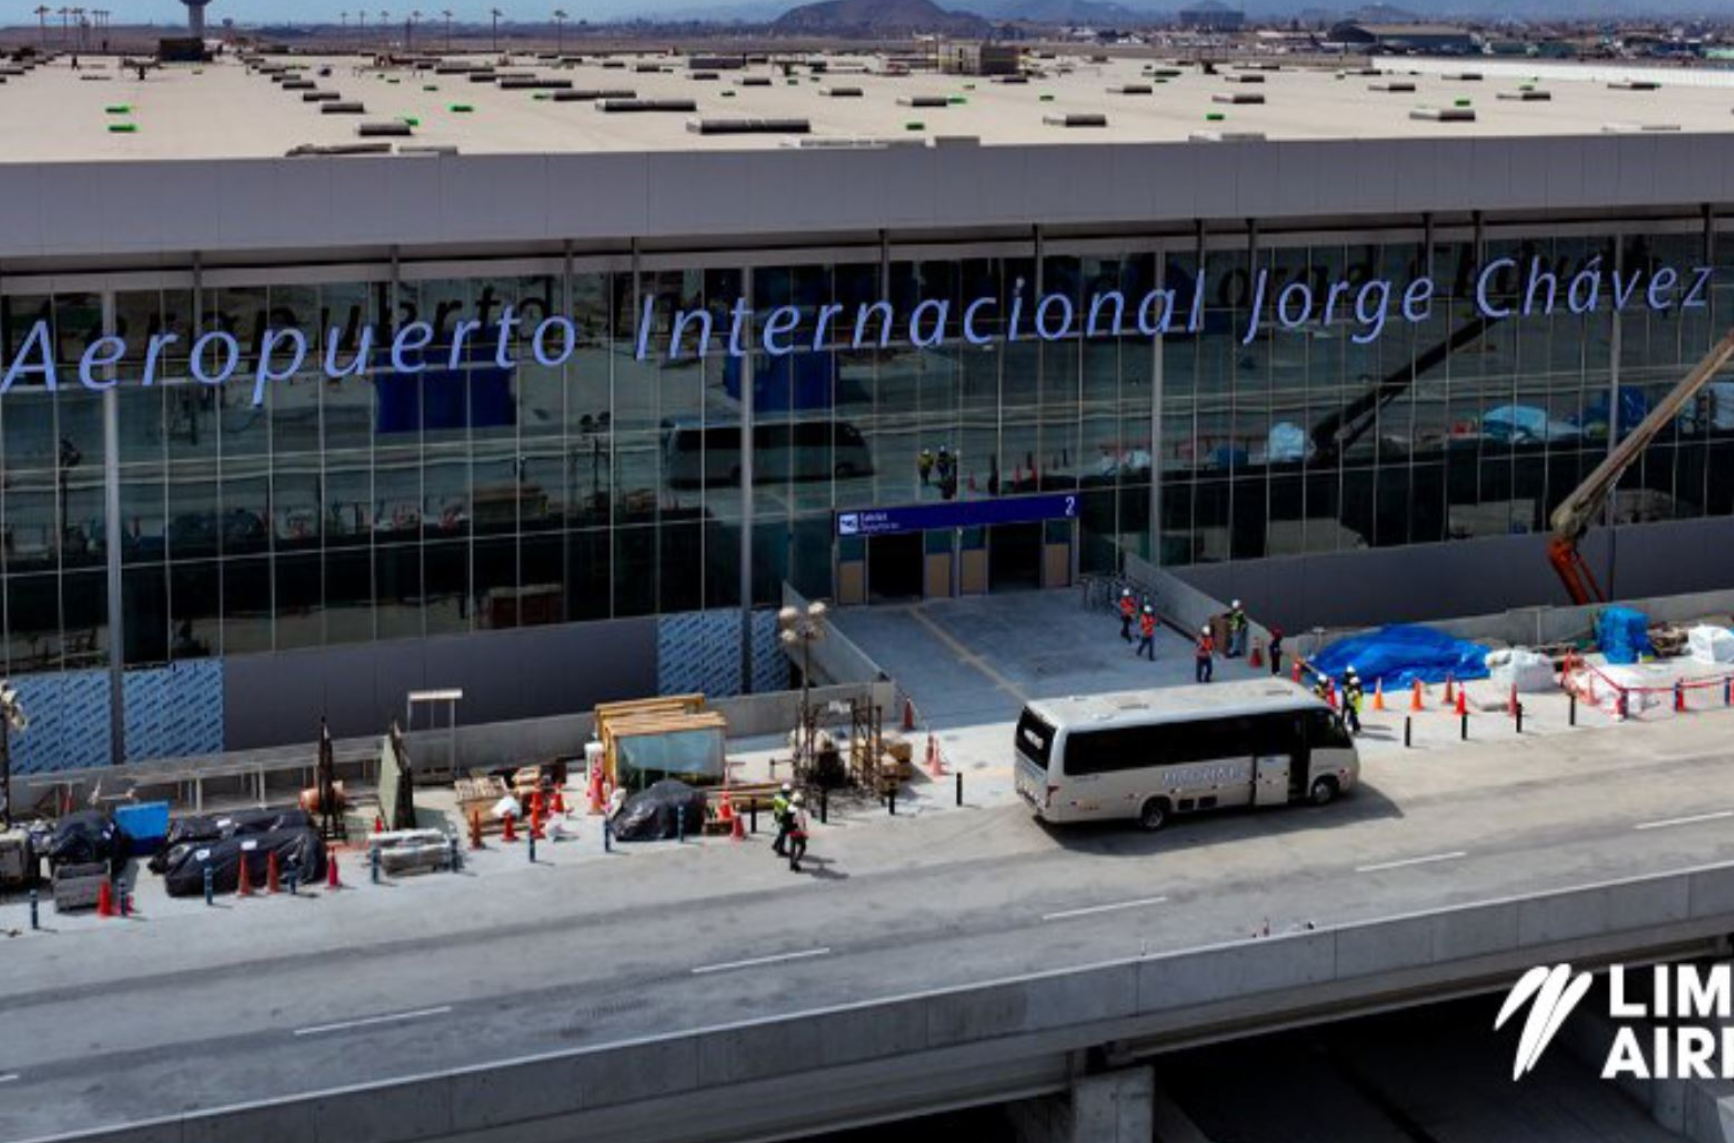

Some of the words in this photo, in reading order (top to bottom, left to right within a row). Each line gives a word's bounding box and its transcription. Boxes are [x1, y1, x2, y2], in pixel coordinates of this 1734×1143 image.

[0, 303, 576, 406] Aeropuerto
[636, 268, 1205, 361] Internacional
[1242, 268, 1434, 345] Jorge
[1476, 256, 1713, 317] Chávez
[1064, 496, 1076, 516] 2
